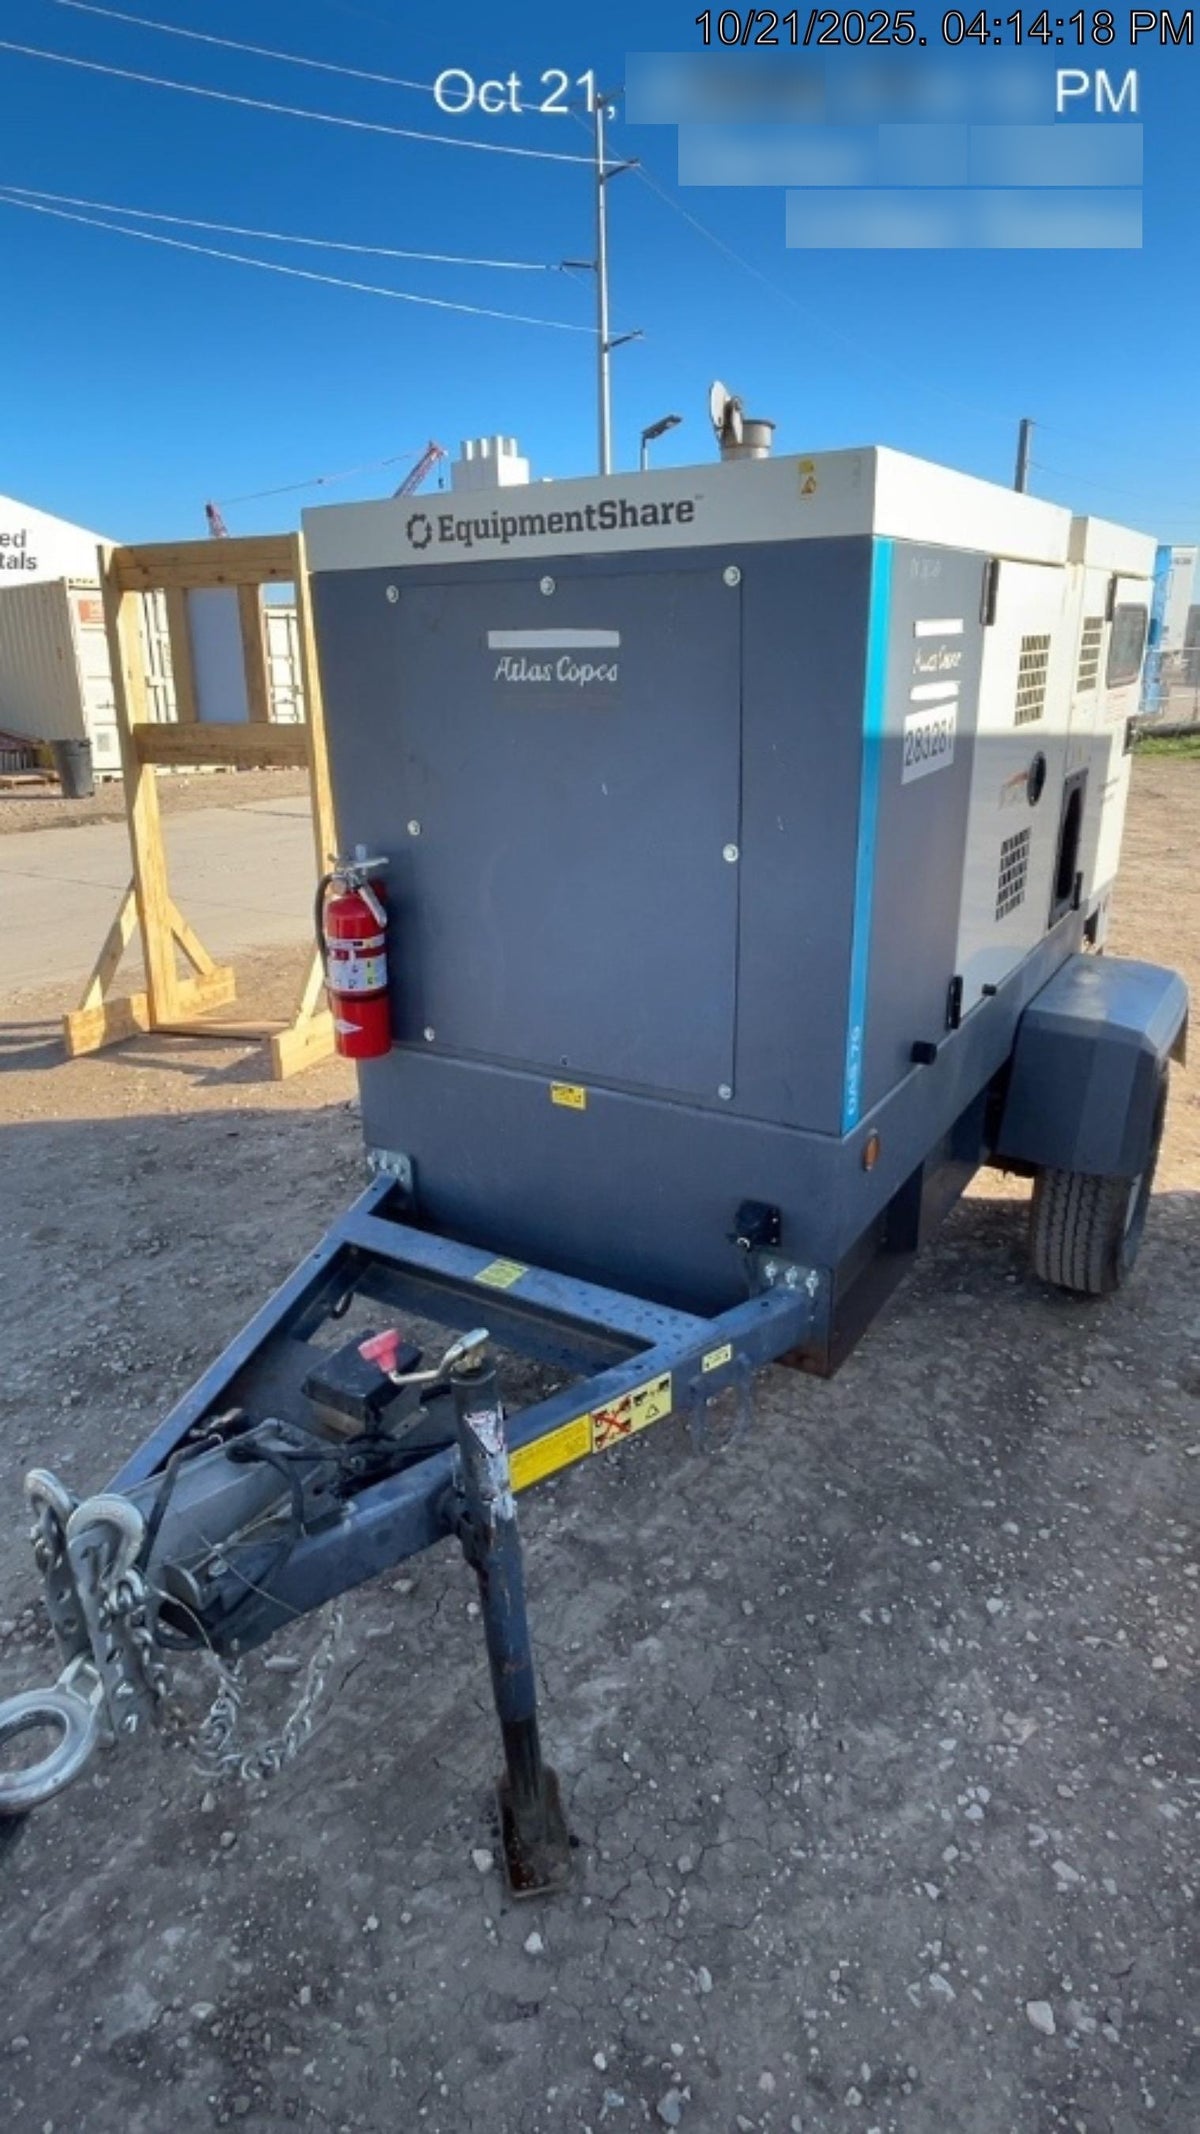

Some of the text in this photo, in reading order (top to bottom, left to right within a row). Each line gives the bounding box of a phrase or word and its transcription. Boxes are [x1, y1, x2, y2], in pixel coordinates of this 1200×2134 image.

[437, 499, 695, 548] EquipmentShare
[0, 528, 27, 548] ed
[493, 656, 554, 682] Atlas
